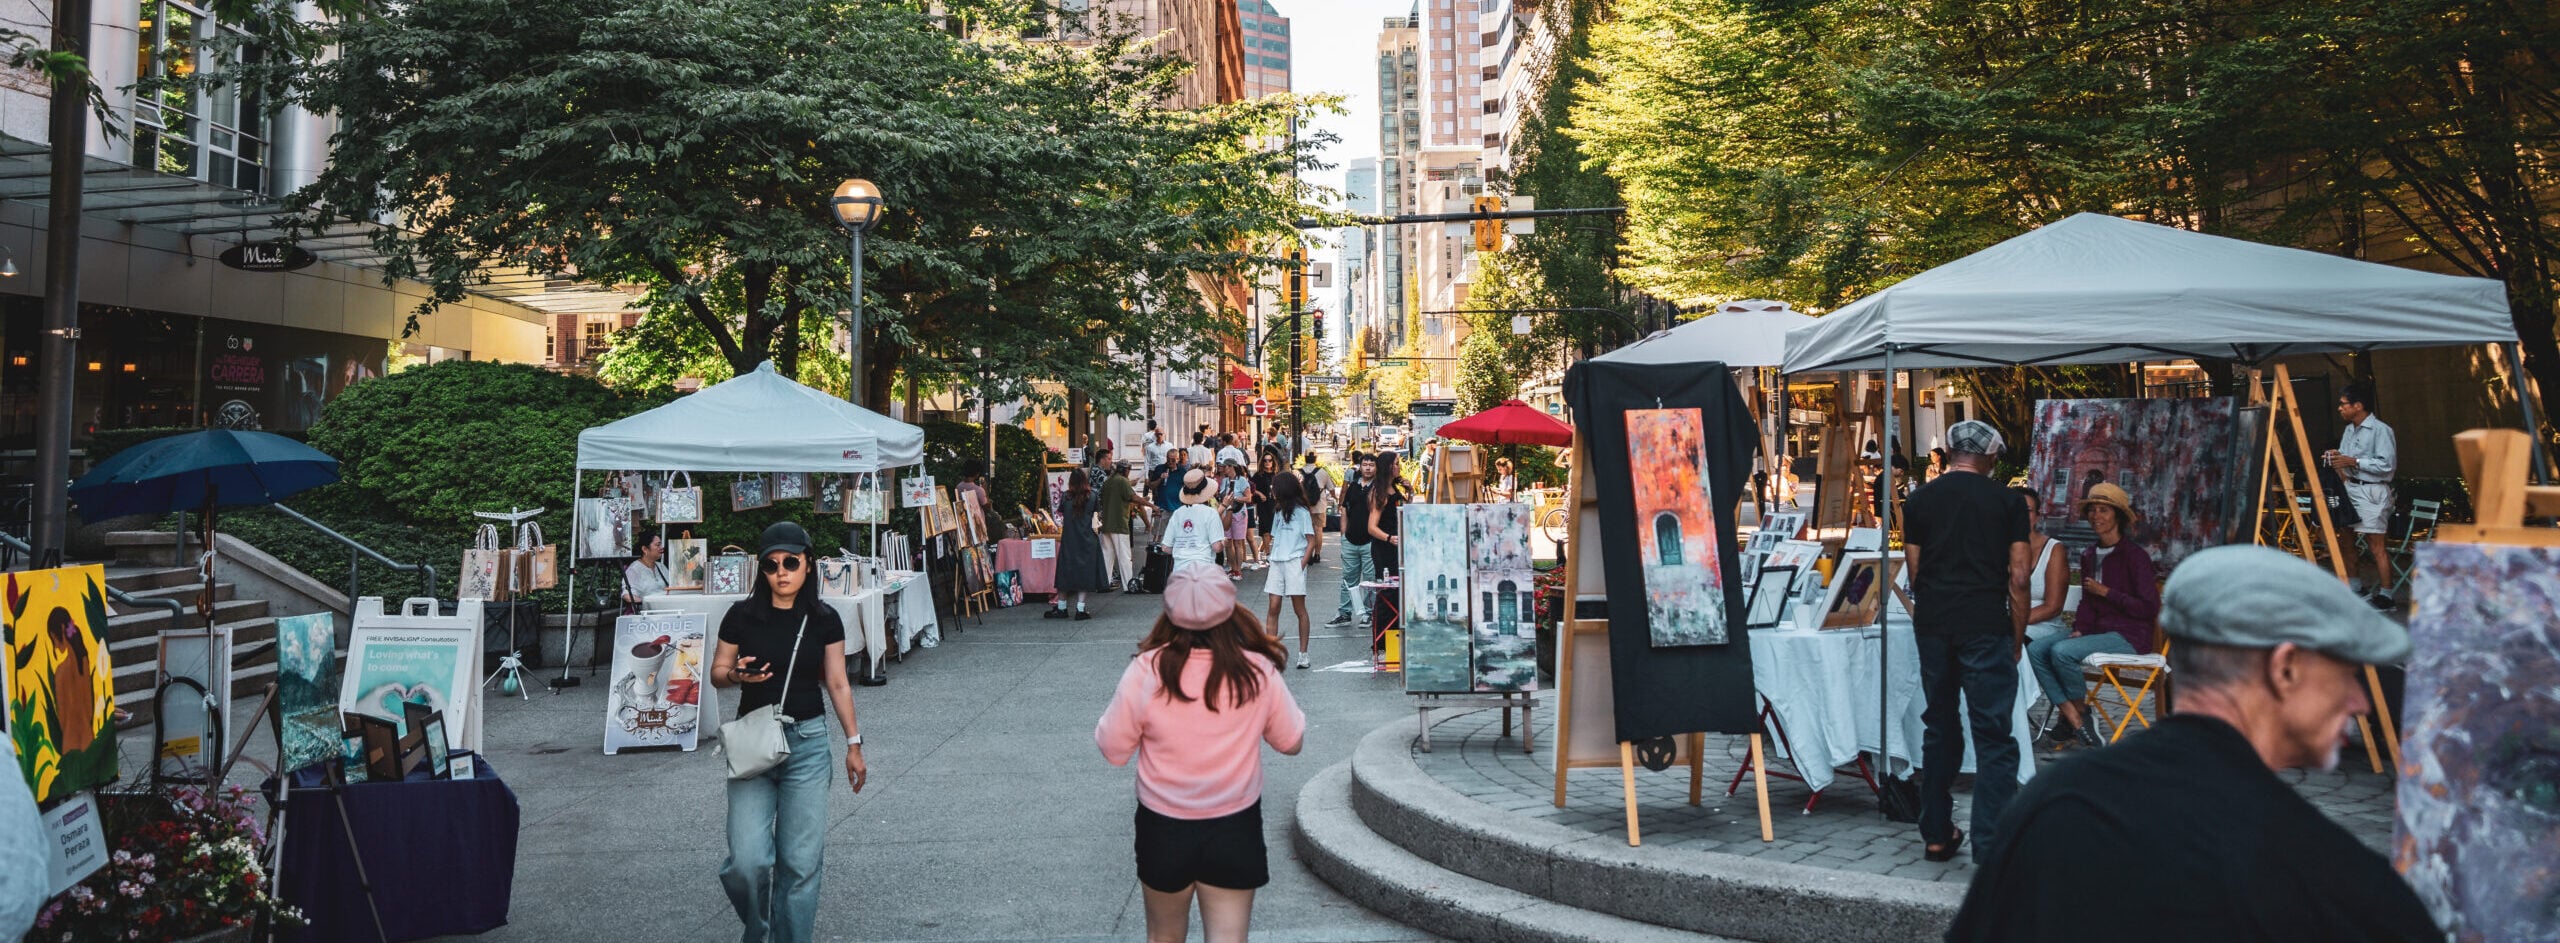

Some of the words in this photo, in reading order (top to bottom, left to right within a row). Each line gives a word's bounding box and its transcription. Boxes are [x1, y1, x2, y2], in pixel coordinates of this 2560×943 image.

[243, 246, 285, 264] Mink
[211, 364, 264, 383] CARRERA
[628, 621, 693, 633] FONDUE
[369, 650, 404, 660] Loving
[406, 650, 439, 660] what's
[368, 663, 379, 671] to
[640, 711, 664, 722] Mink
[61, 823, 88, 845] Osmara
[64, 838, 91, 859] Peraza
